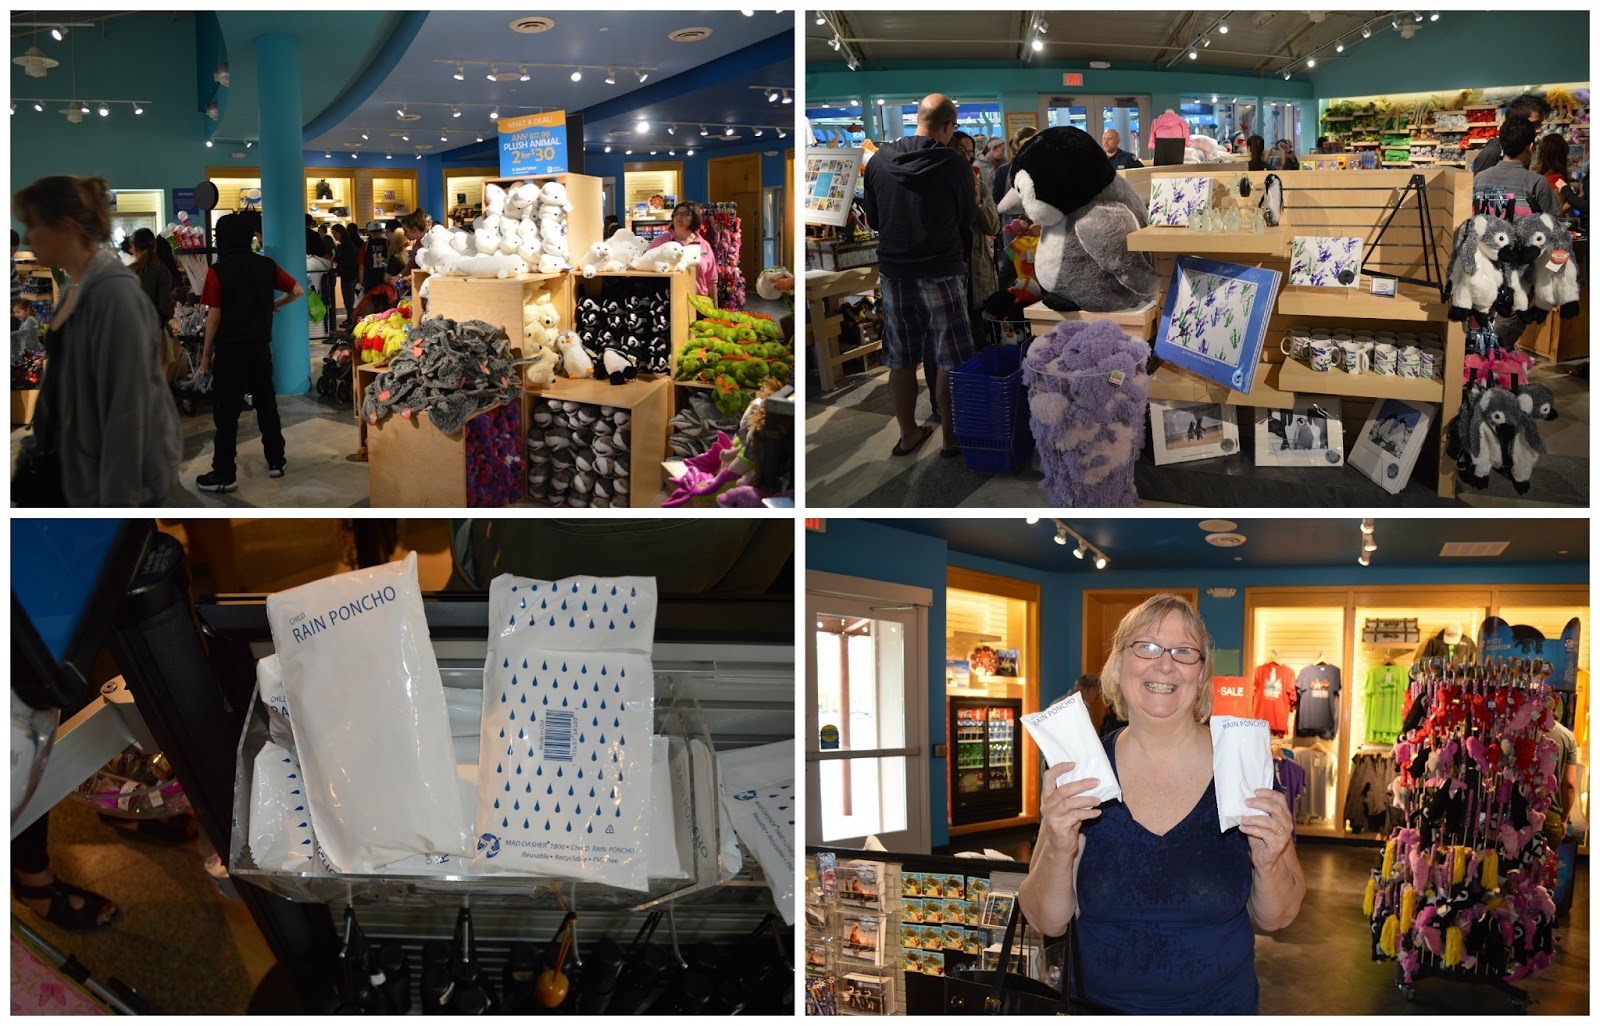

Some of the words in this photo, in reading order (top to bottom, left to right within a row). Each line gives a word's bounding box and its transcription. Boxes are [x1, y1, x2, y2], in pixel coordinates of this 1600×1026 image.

[507, 121, 526, 129] WHAT
[533, 116, 553, 125] DEAL!
[503, 141, 528, 151] PLUSH
[529, 137, 562, 148] ANIMAL
[511, 133, 528, 142] ANY
[512, 150, 521, 164] 2
[521, 151, 531, 159] for
[289, 612, 306, 626] CHILD
[292, 615, 327, 644] RAIN
[328, 586, 396, 626] PONCHO
[1220, 686, 1244, 697] SALE
[270, 706, 290, 718] RA
[1032, 713, 1048, 727] RAIN
[1048, 698, 1076, 716] PONCHO
[1222, 721, 1239, 730] RAIN
[1239, 720, 1267, 728] PONCHO
[504, 839, 521, 847] MAD
[591, 845, 606, 853] RAIN
[608, 846, 635, 854] PONCHO
[521, 851, 549, 860] Reusable
